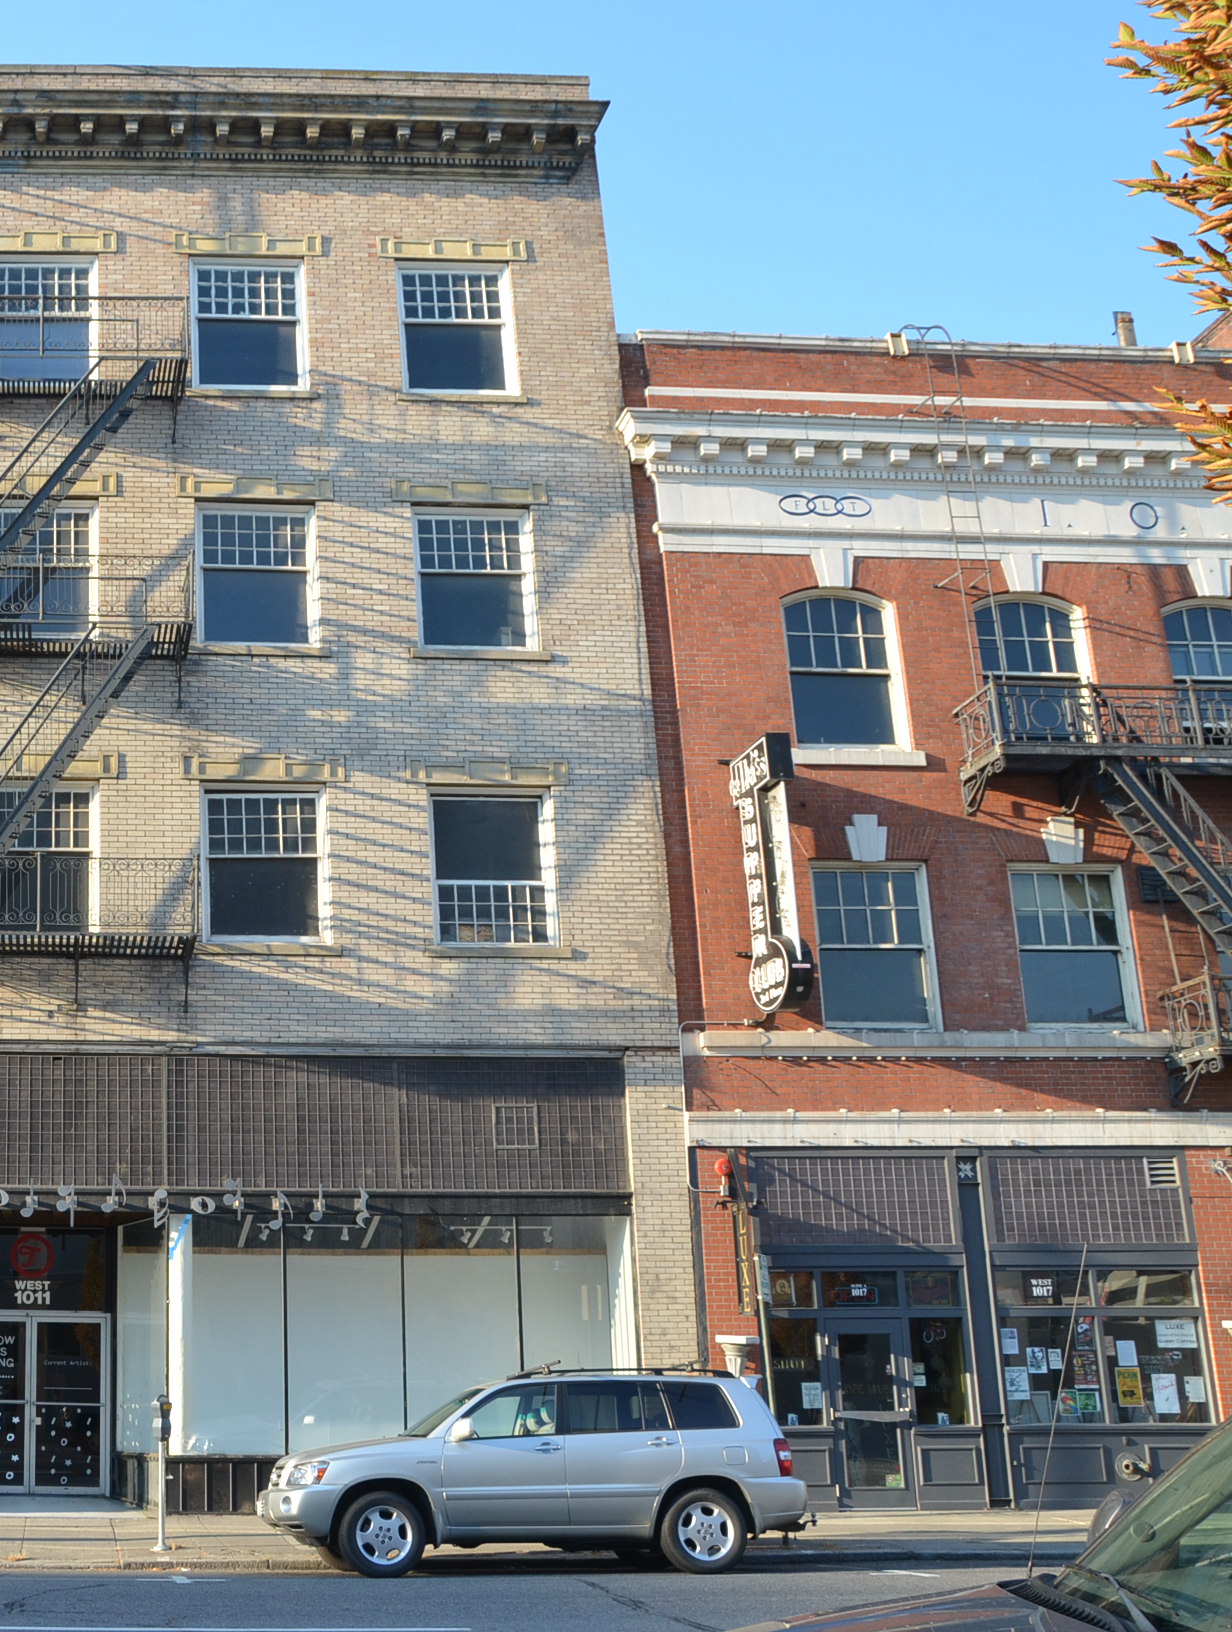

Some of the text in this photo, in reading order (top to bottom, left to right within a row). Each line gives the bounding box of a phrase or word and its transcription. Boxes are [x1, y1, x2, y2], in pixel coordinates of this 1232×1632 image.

[739, 797, 768, 957] SUPPER
[739, 1210, 751, 1312] LUXE
[14, 1280, 51, 1290] WEST
[1030, 1278, 1053, 1286] WEST
[851, 1288, 867, 1297] 1017
[1032, 1286, 1053, 1297] 1017
[14, 1290, 51, 1305] 1011
